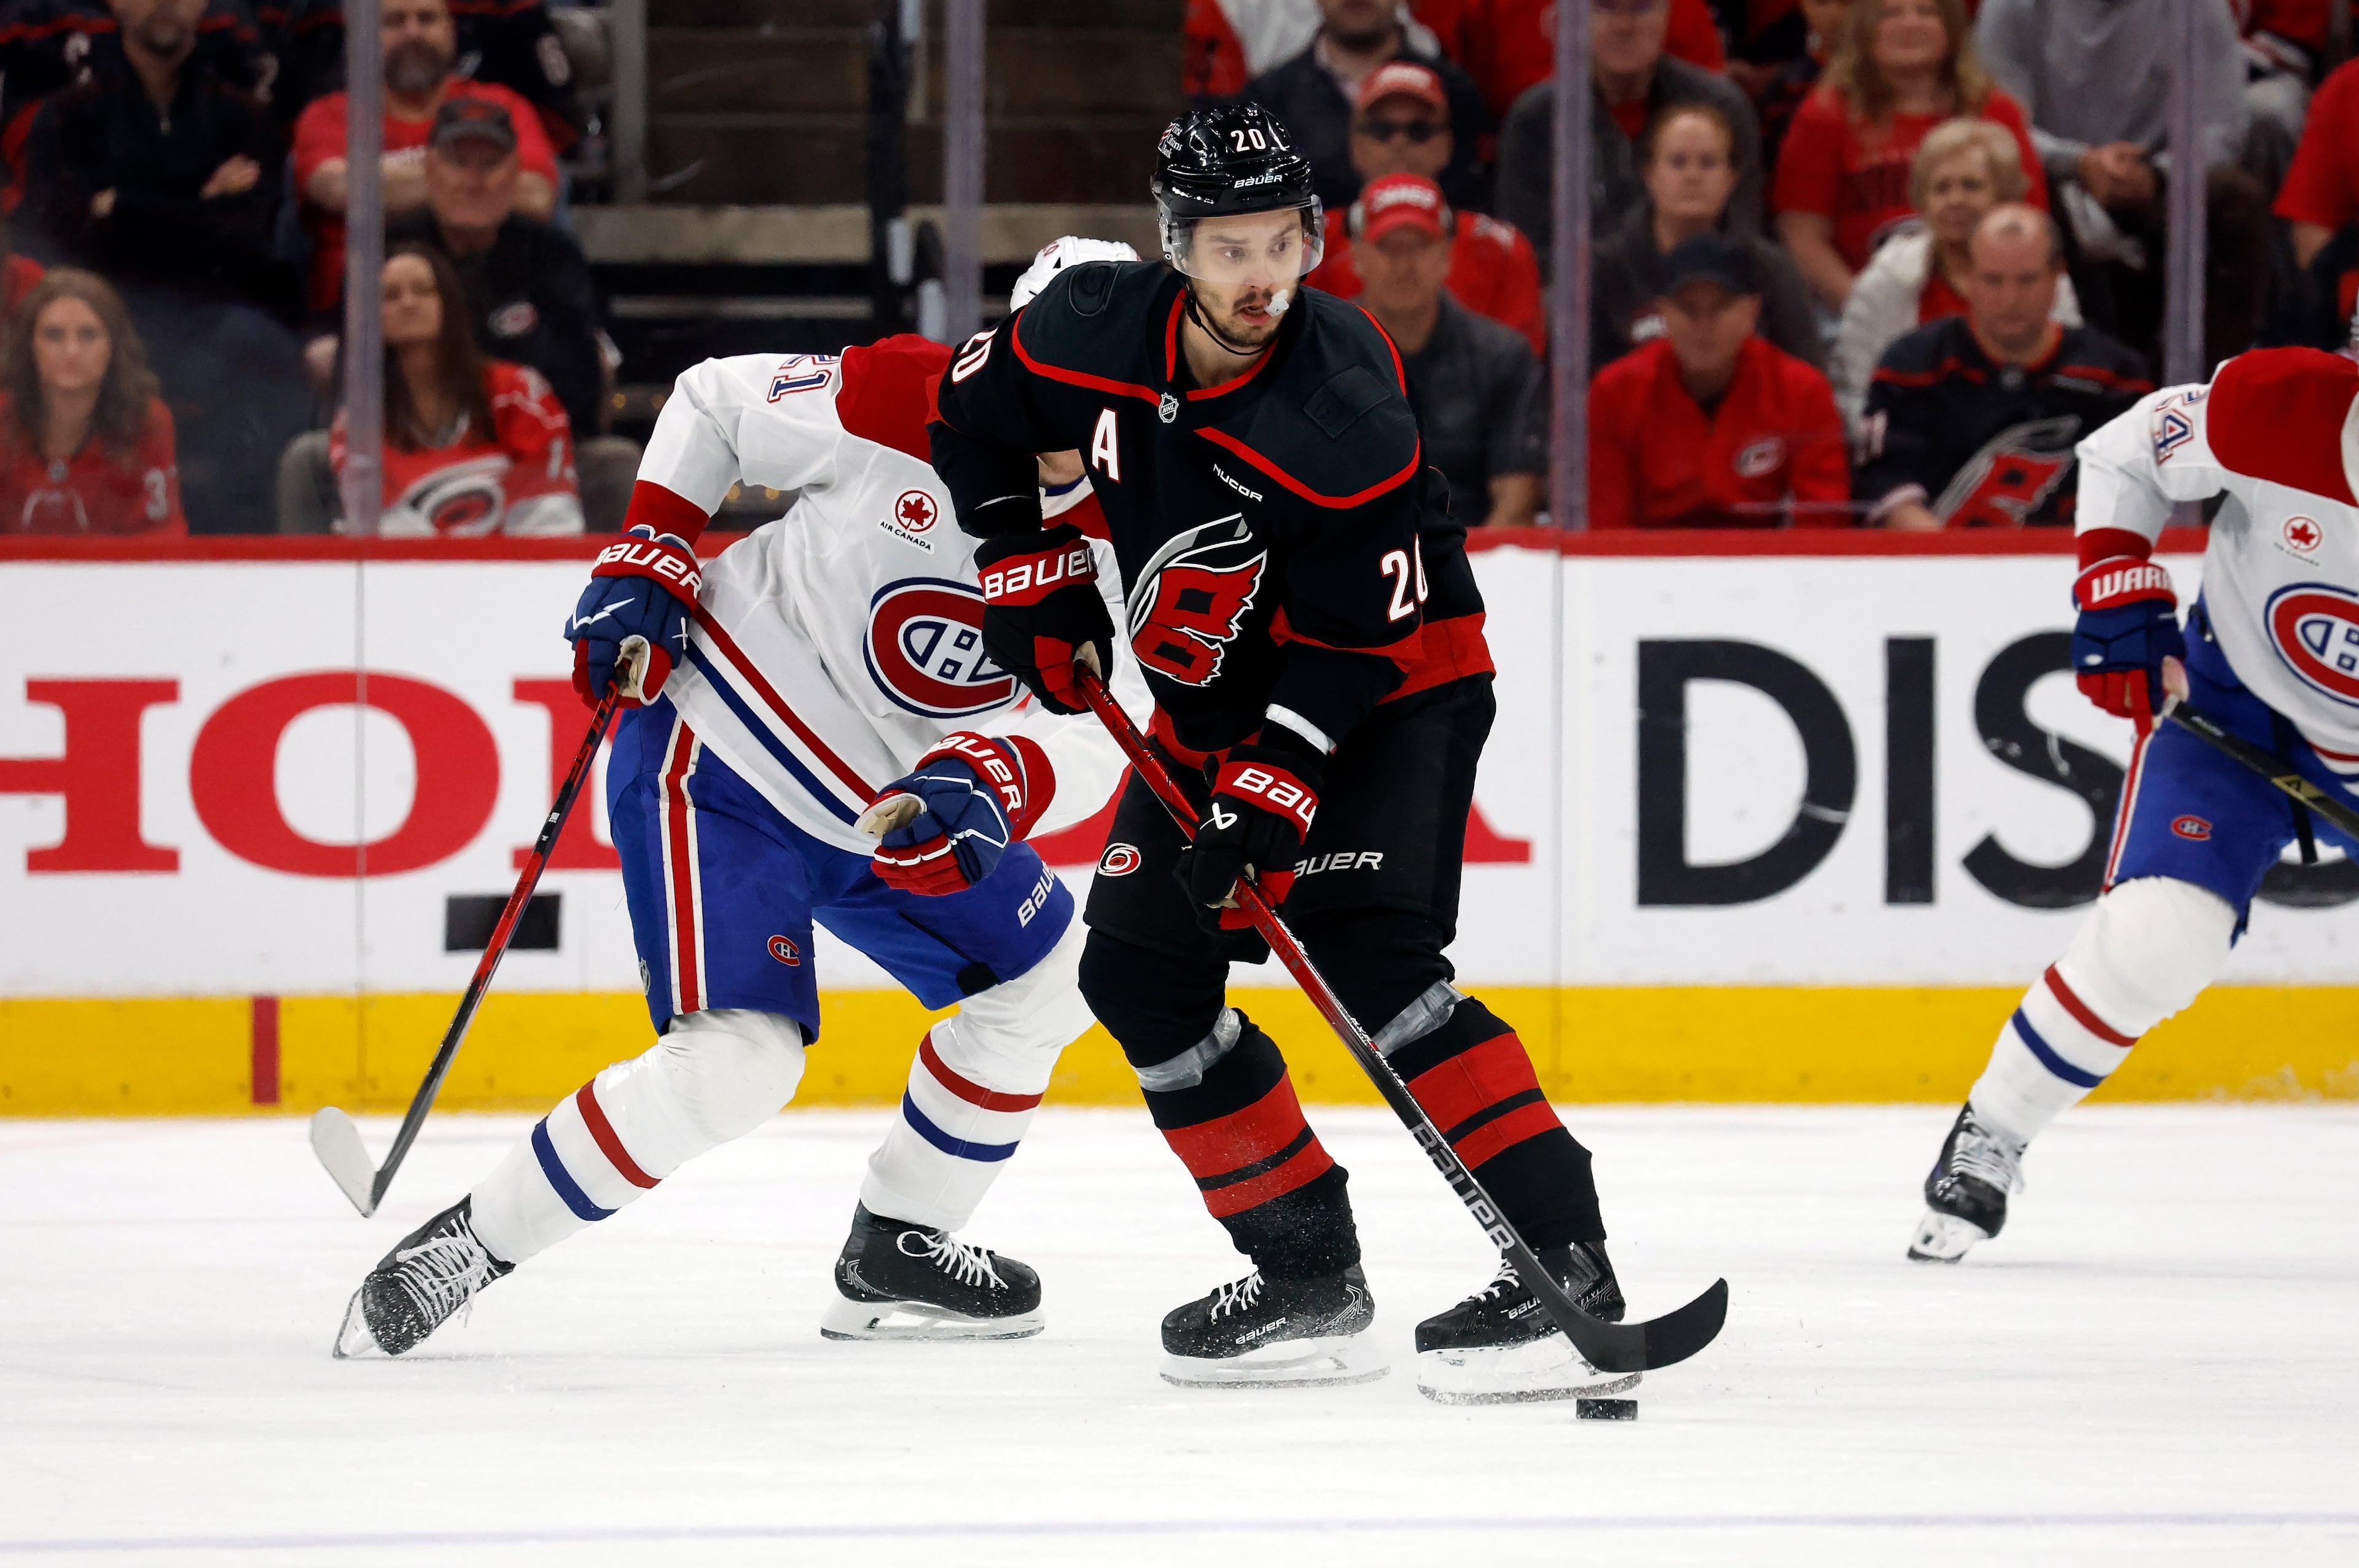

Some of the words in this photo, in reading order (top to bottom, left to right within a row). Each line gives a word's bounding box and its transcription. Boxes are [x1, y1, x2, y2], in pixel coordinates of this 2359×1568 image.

[1230, 128, 1267, 152] 20
[1091, 406, 1121, 483] A
[1213, 463, 1263, 502] NUCOR
[880, 521, 893, 532] AIR
[894, 529, 931, 550] CANADA
[928, 736, 1022, 814] AUER
[1637, 630, 2359, 910] DIS
[1232, 768, 1316, 833] BAU
[1293, 851, 1383, 879] AUER
